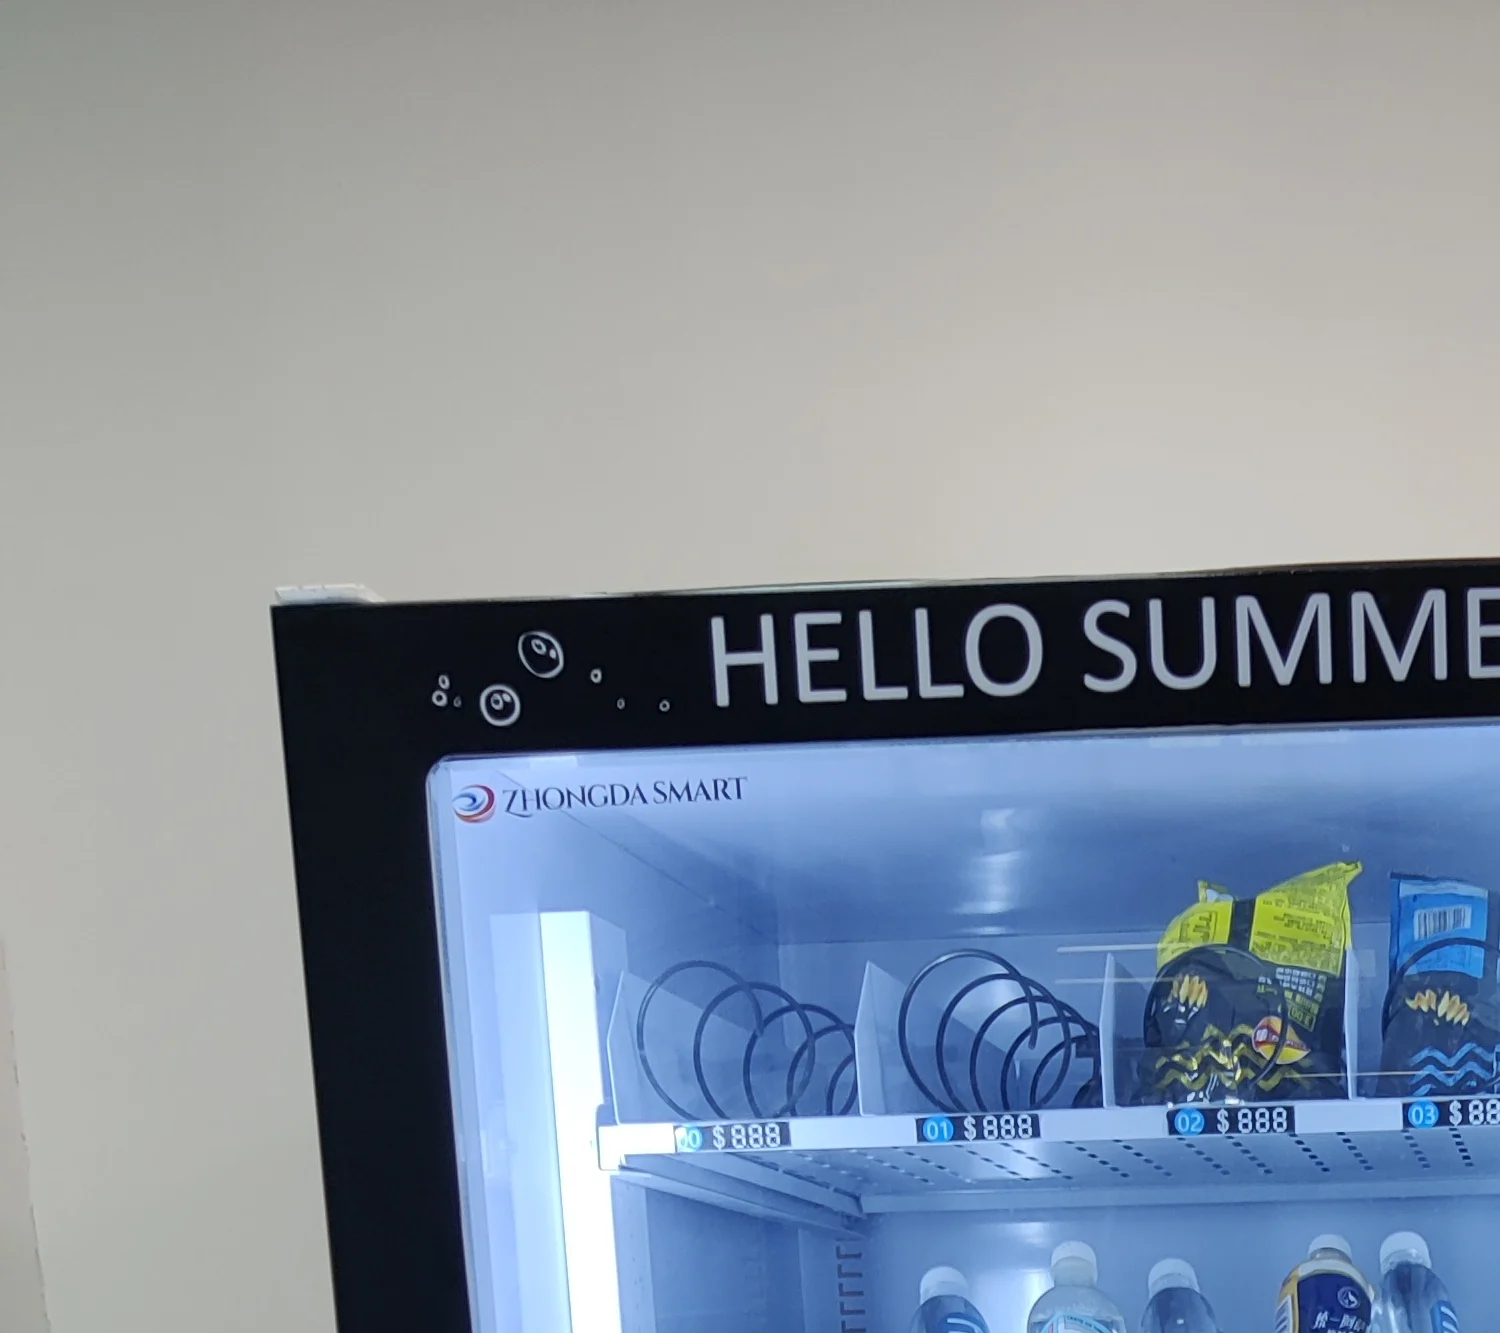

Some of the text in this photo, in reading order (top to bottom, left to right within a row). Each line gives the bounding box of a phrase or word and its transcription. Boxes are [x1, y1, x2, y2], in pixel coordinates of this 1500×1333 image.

[711, 604, 1044, 708] HELLO
[502, 776, 748, 817] ZHONGDA SMART
[1178, 1114, 1201, 1132] 02
[1412, 1107, 1436, 1125] 03
[927, 1121, 949, 1140] 01
